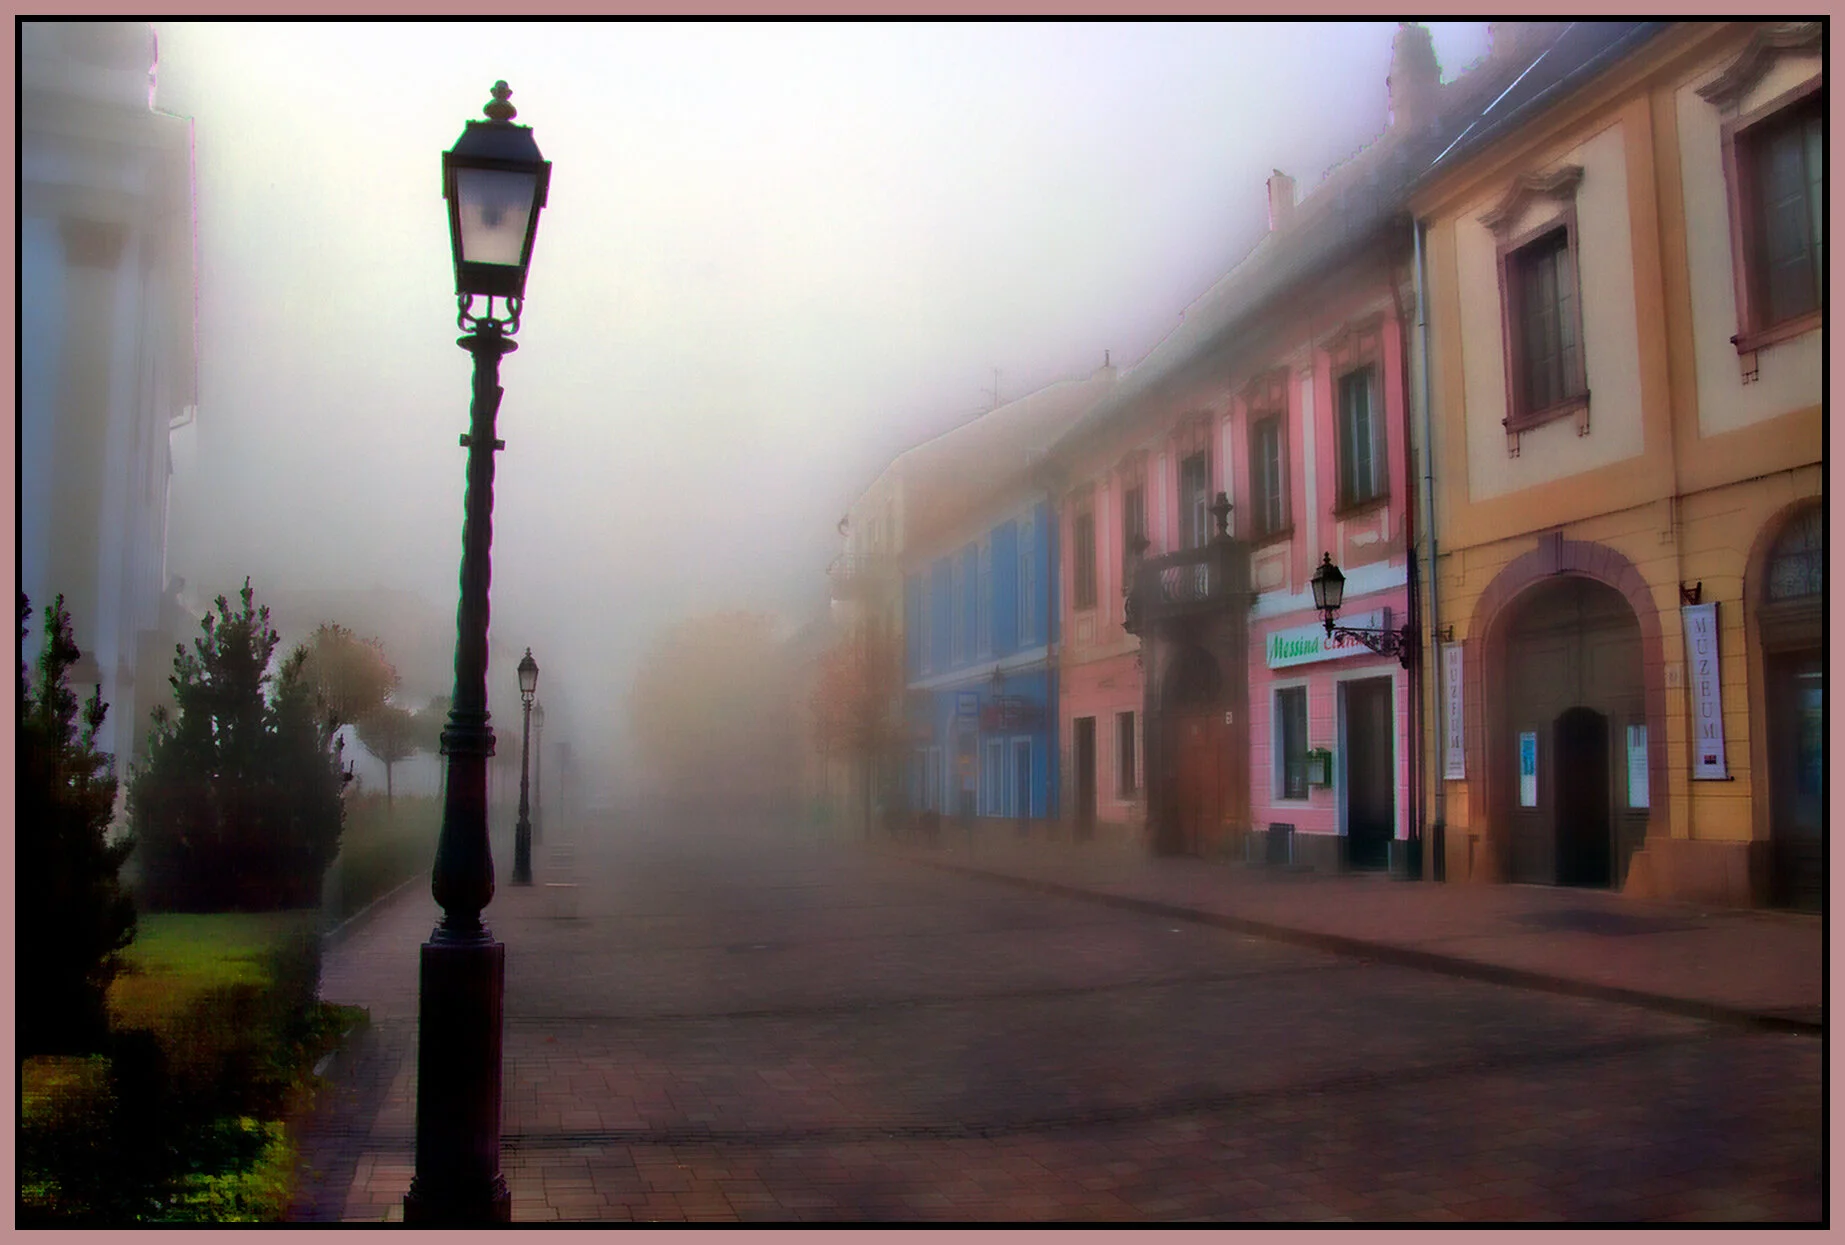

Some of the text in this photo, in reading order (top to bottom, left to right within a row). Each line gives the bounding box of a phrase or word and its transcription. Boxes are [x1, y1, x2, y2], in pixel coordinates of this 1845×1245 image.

[1271, 635, 1319, 660] Messina
[1695, 617, 1715, 739] MUZEUM
[1449, 651, 1460, 749] MUZEUM
